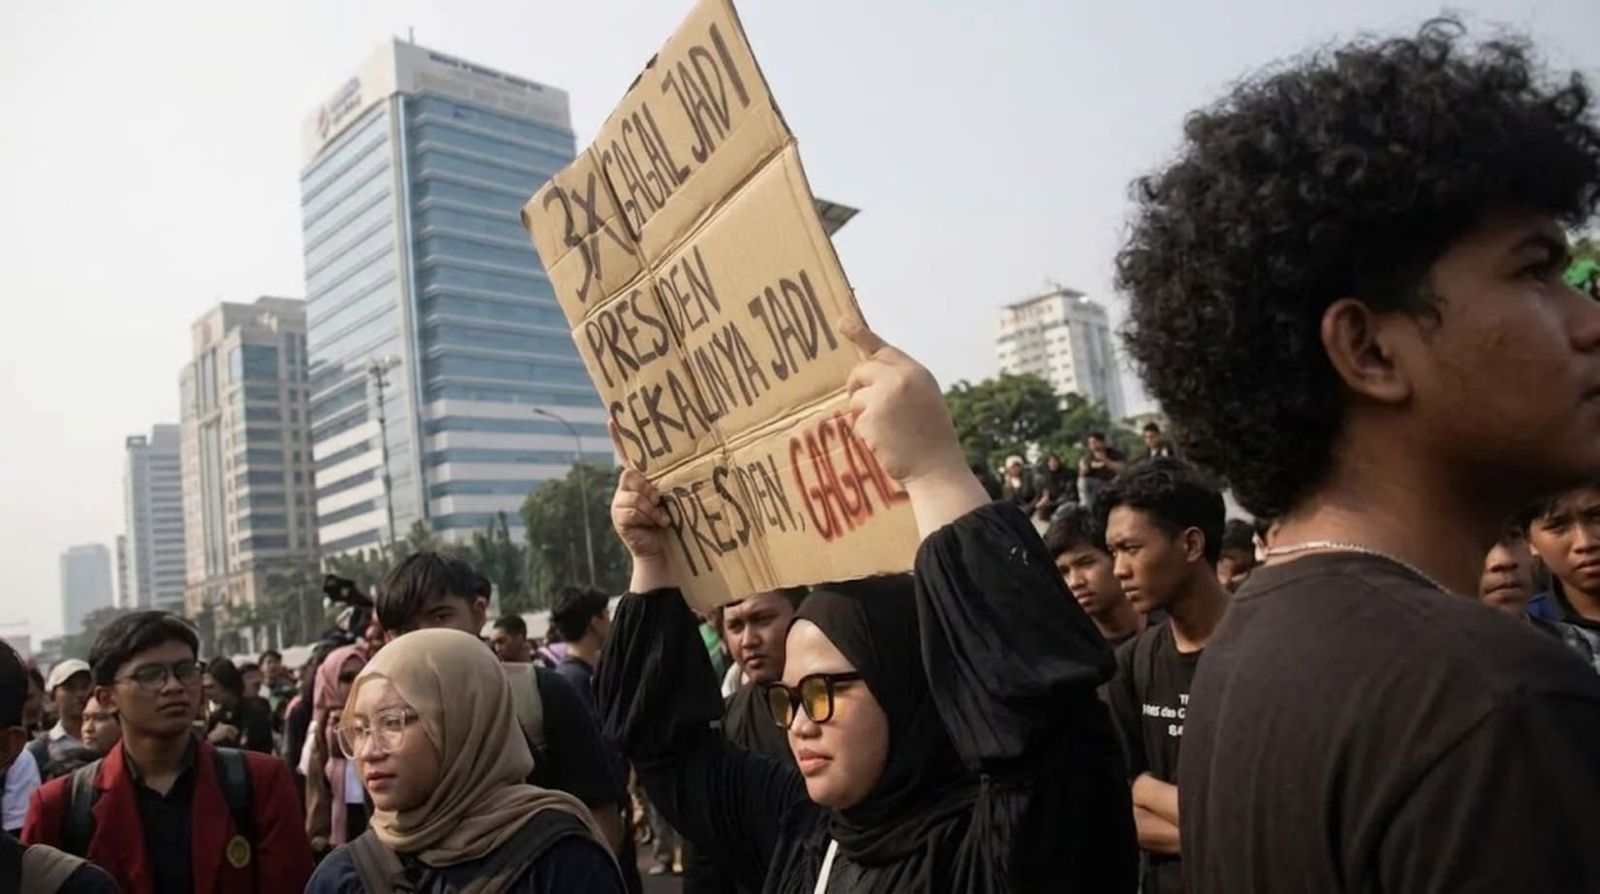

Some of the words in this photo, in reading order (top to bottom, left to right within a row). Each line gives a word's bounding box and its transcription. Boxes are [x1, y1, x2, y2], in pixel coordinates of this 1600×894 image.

[543, 173, 636, 302] 3X
[602, 103, 690, 242] GAGAL
[661, 22, 750, 163] JADI
[586, 246, 721, 388] PRESIDEN
[610, 322, 770, 473] SEKALINYA
[748, 269, 838, 381] JADI
[789, 411, 911, 543] GAGAL
